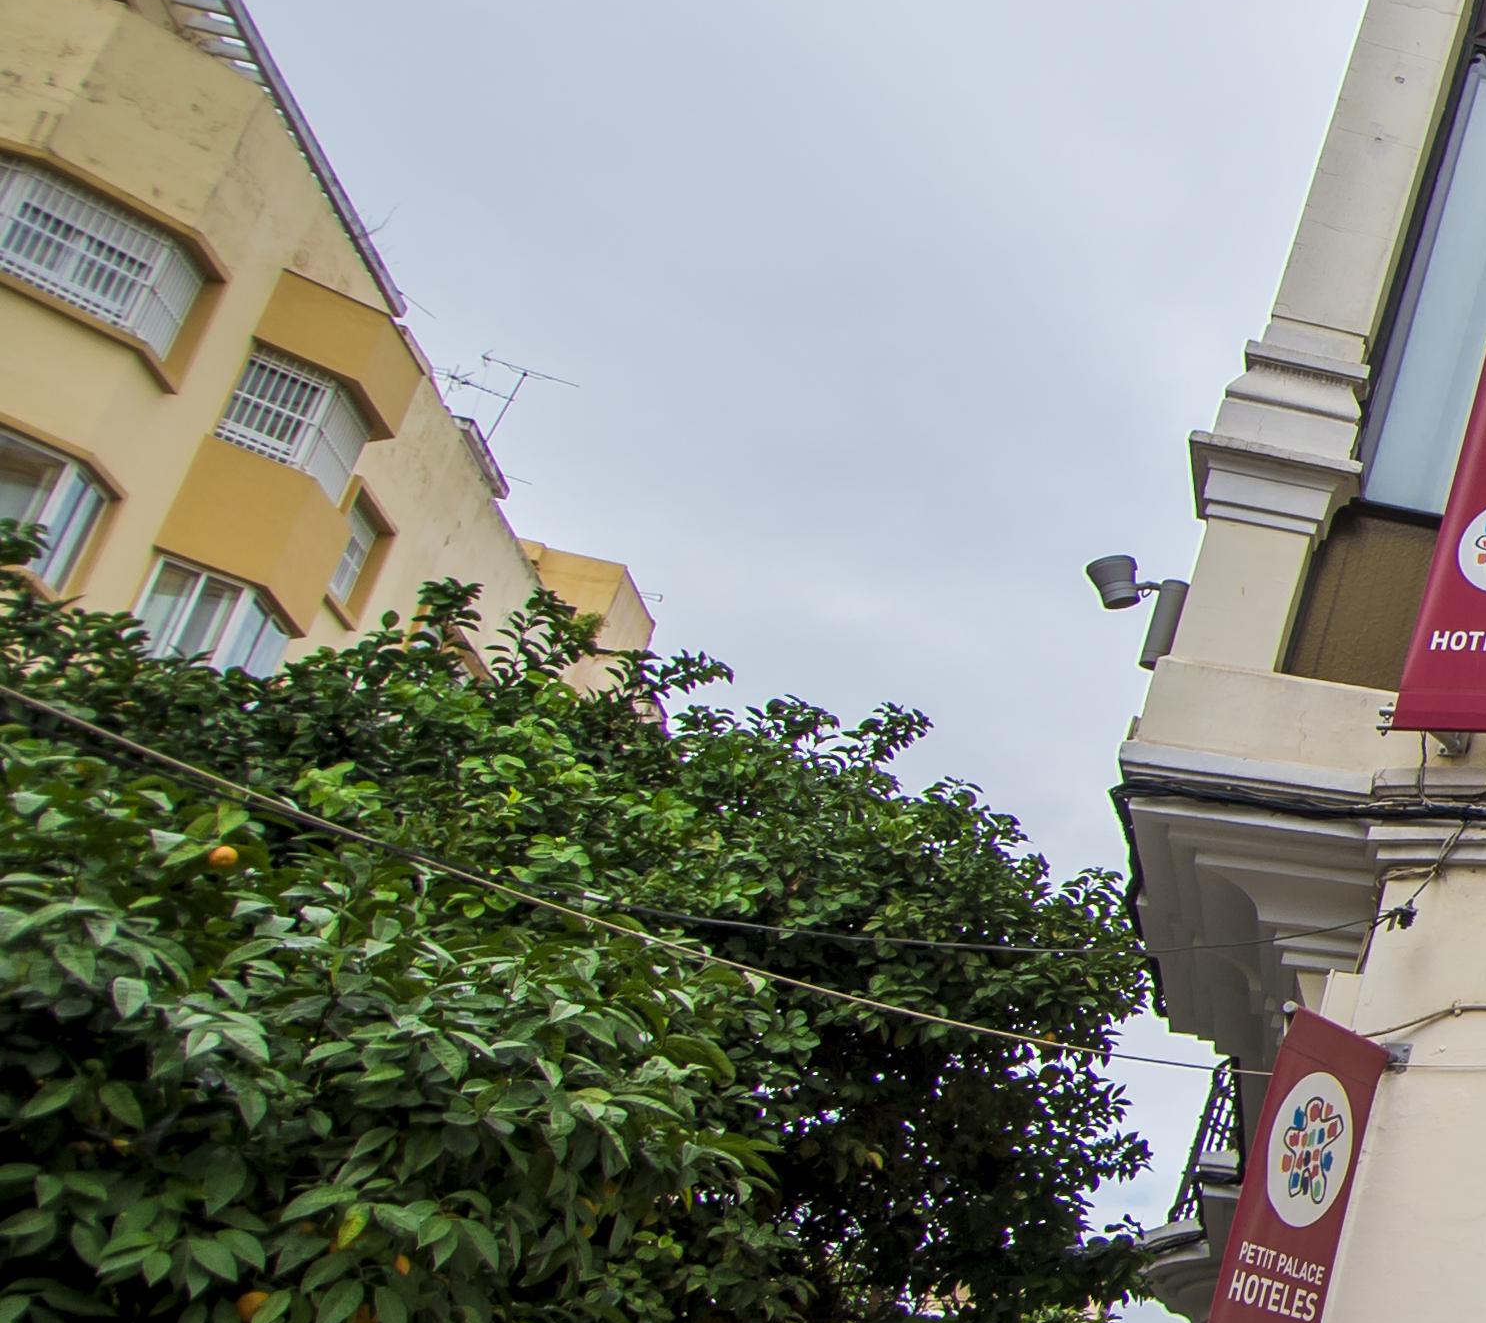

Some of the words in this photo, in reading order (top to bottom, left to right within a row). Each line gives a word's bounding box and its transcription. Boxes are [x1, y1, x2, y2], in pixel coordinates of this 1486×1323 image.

[1238, 1240, 1278, 1270] PETIT
[1276, 1253, 1326, 1286] PALACE
[1227, 1268, 1319, 1322] HOTELES
